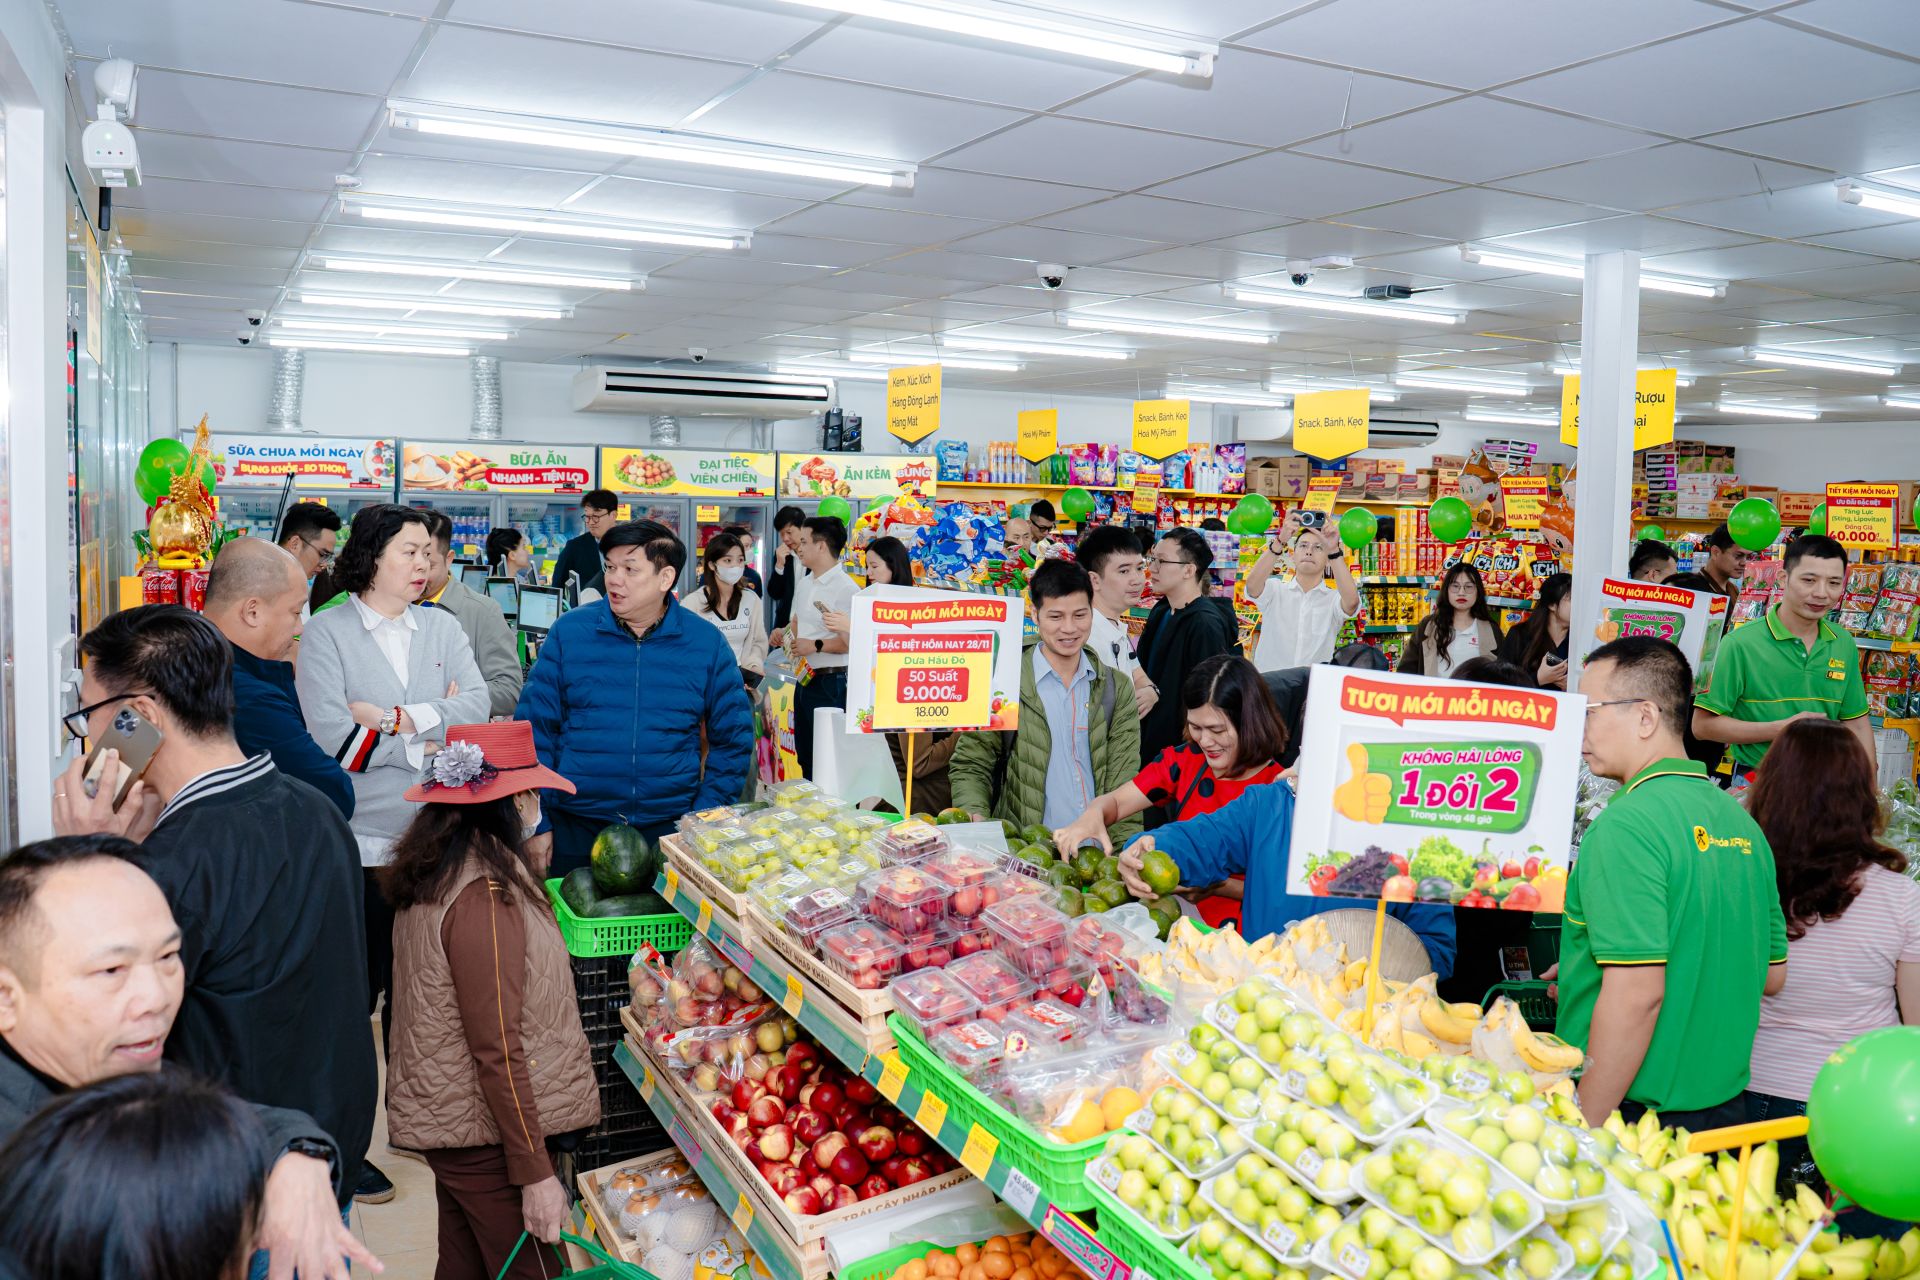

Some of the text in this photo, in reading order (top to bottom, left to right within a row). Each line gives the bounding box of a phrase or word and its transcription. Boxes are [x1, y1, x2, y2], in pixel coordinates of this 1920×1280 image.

[923, 394, 938, 407] Lạnh
[1635, 392, 1665, 406] Rượu
[1139, 414, 1157, 423] Snack,
[1176, 412, 1187, 421] Kẹo
[1298, 416, 1363, 428] Snack, Bánh, Kẹo
[228, 444, 364, 458] SỮA CHUA MỖI NGÀY
[510, 450, 567, 466] BỮA ĂN
[240, 464, 270, 475] BỤNG
[271, 462, 299, 474] KHỎE
[304, 464, 317, 472] EO
[319, 463, 347, 474] THON
[699, 458, 750, 472] ĐẠI TIỆC
[491, 472, 534, 483] NHANH
[541, 470, 565, 483] TIỆN
[566, 471, 584, 483] LỢI
[690, 471, 758, 484] VIÊN CHIÊN
[843, 465, 931, 481] ĂN KÈM BÙNG
[1861, 486, 1874, 494] MỖI
[1605, 584, 1691, 604] TƯƠI MỚI MỖI NGÀY
[876, 602, 1004, 620] TƯƠI MỚI MỖI NGÀY
[880, 638, 989, 651] ĐẶC BIỆT HÔM NAY 28/11
[904, 656, 925, 665] Dưa
[909, 669, 958, 682] 50 Suất
[903, 686, 950, 701] 9.000
[915, 706, 948, 717] 18.000
[1347, 687, 1552, 723] TƯƠI MỚI MỖI NGÀY
[1401, 747, 1523, 765] KHÔNG HÀI LÒNG
[1399, 768, 1520, 812] 1 ĐỔI 2
[1410, 809, 1493, 825] Trong vòng 48 giờ
